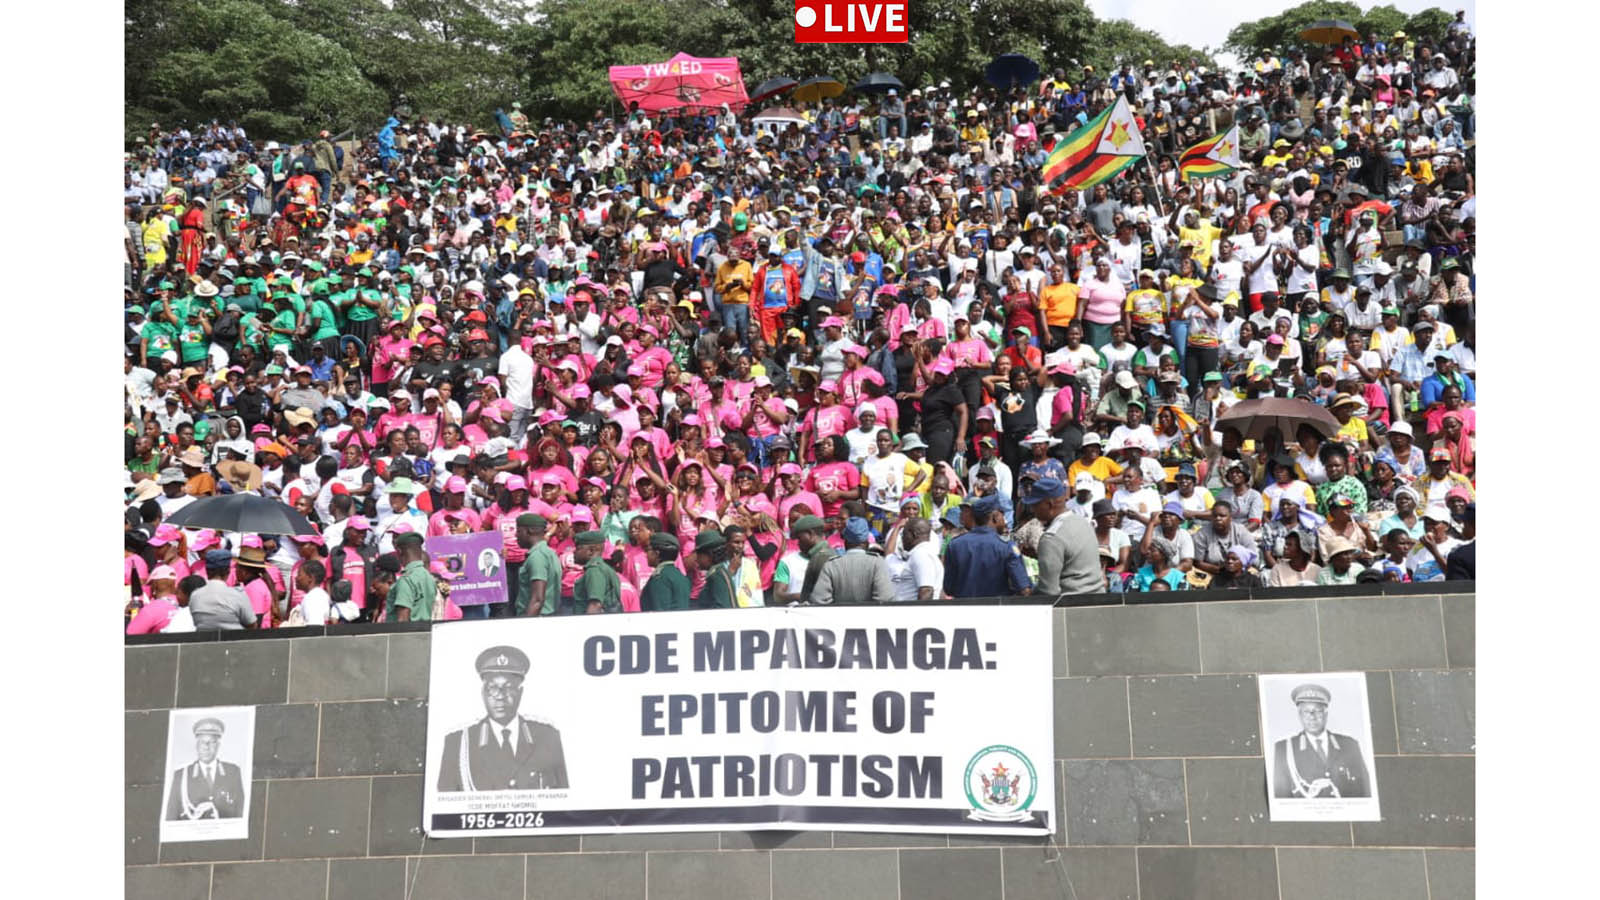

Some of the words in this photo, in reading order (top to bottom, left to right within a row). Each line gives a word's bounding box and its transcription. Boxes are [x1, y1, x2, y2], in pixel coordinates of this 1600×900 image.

[642, 61, 702, 77] YW4ED
[584, 633, 678, 676] CDE
[694, 628, 996, 672] MPABANGA:
[642, 691, 857, 736] EPITOME
[872, 691, 935, 734] OF
[632, 754, 942, 799] PATRIOTISM
[460, 813, 545, 829] 1956-2026
